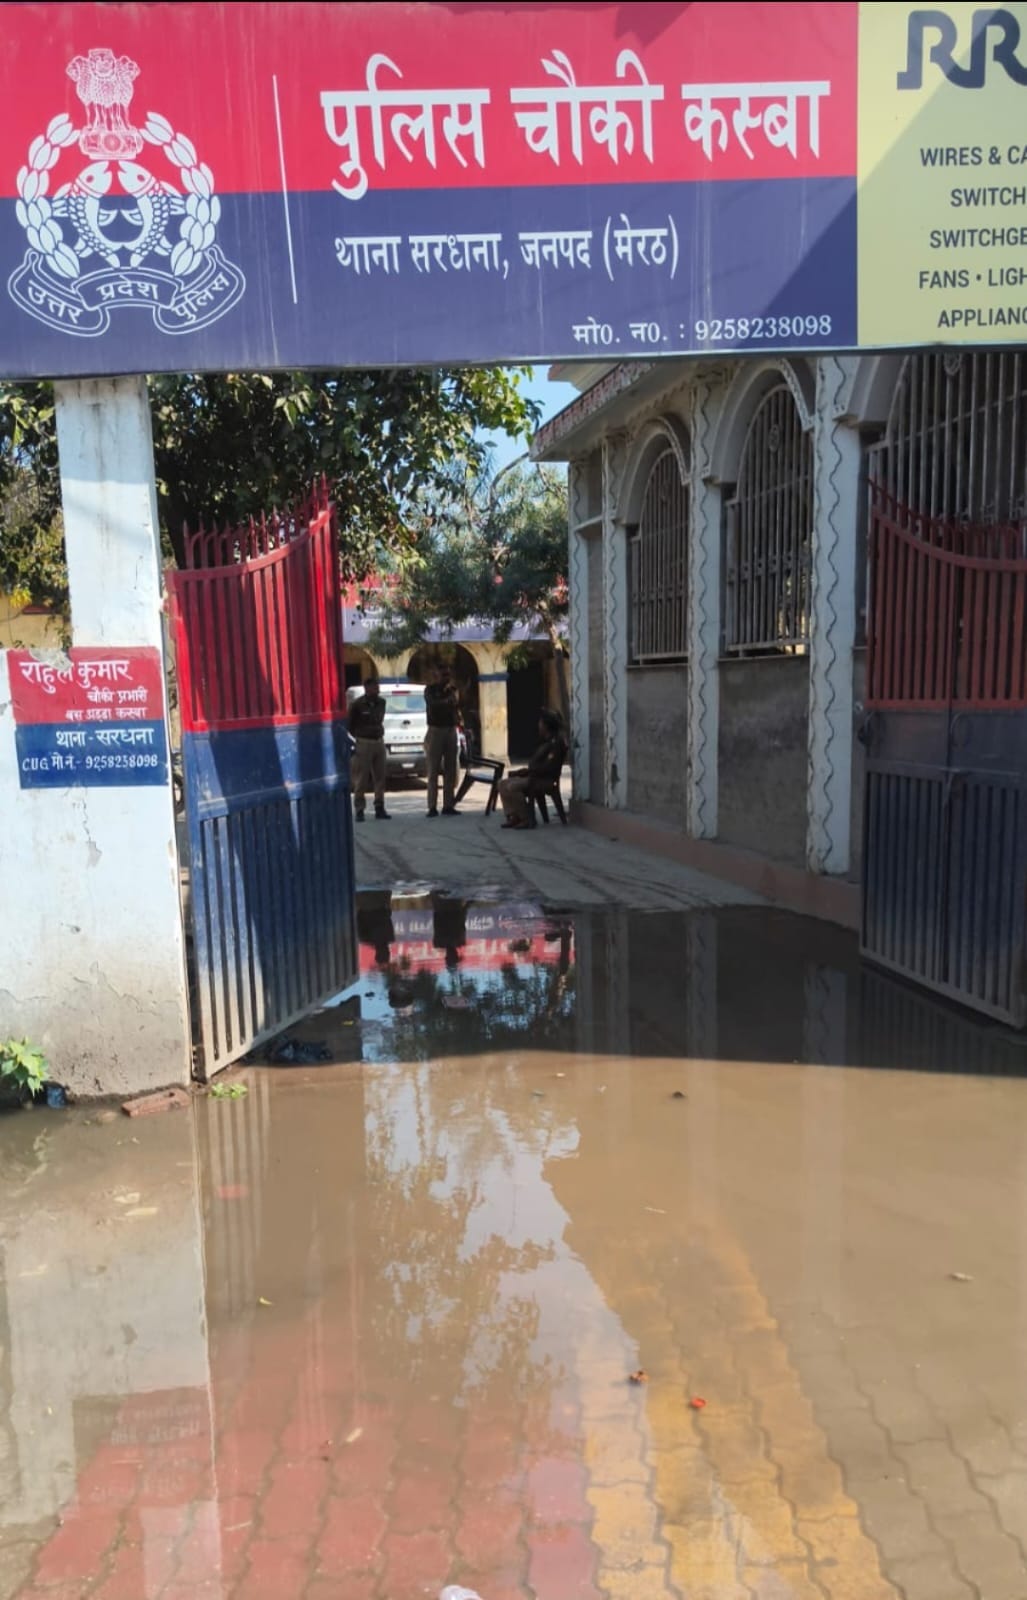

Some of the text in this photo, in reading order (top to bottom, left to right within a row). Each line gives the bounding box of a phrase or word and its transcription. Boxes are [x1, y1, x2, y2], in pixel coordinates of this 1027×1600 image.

[320, 49, 831, 200] पुलिस चौकी कस्बा
[920, 147, 983, 167] WIRES
[988, 146, 1002, 165] &
[335, 236, 401, 275] थाना
[518, 230, 592, 269] जनपद
[603, 213, 678, 281] (मेरठ)
[919, 269, 970, 289] FANS
[28, 271, 230, 325] उत्तर प्रदेश पुलिस
[695, 315, 832, 341] 9258238098
[76, 660, 133, 688] कुमार
[22, 757, 49, 771] CUG
